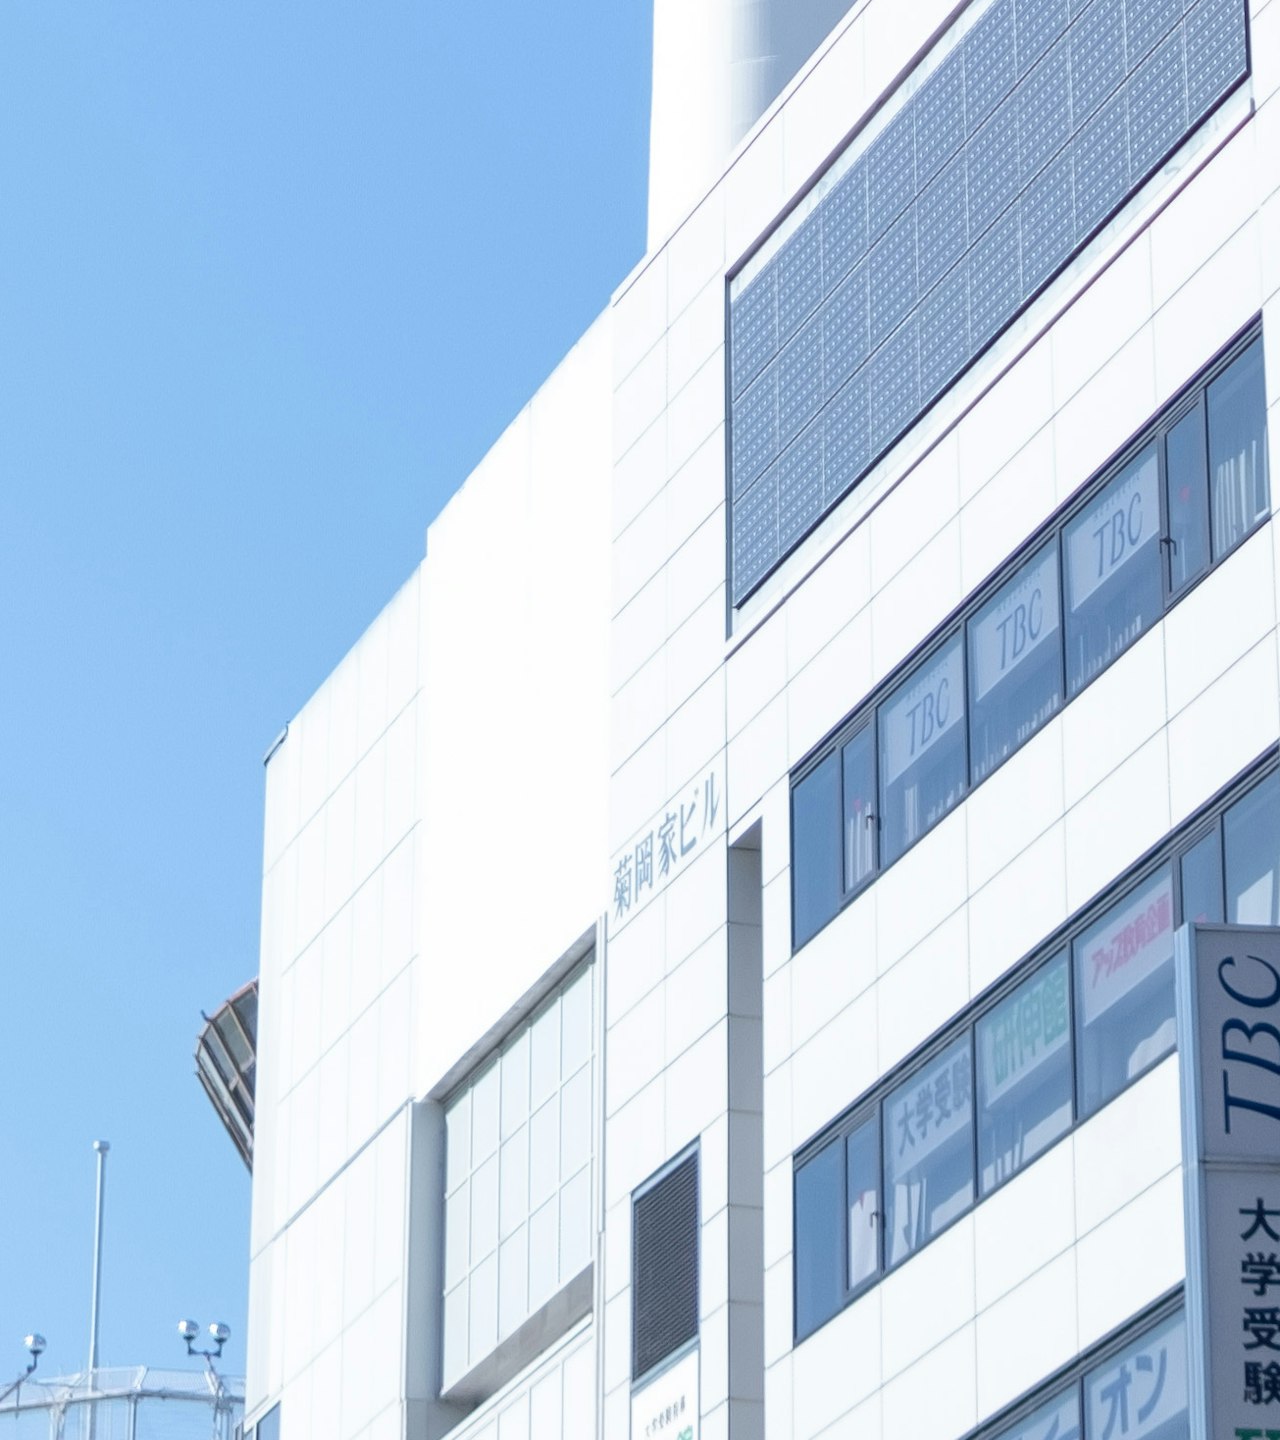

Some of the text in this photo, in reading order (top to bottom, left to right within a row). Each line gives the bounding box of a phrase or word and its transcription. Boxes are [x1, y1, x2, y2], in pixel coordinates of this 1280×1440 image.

[1093, 491, 1144, 578] TBC
[996, 588, 1043, 670] TBC
[905, 678, 951, 756] TBC
[613, 771, 722, 923] 菊岡家ビル
